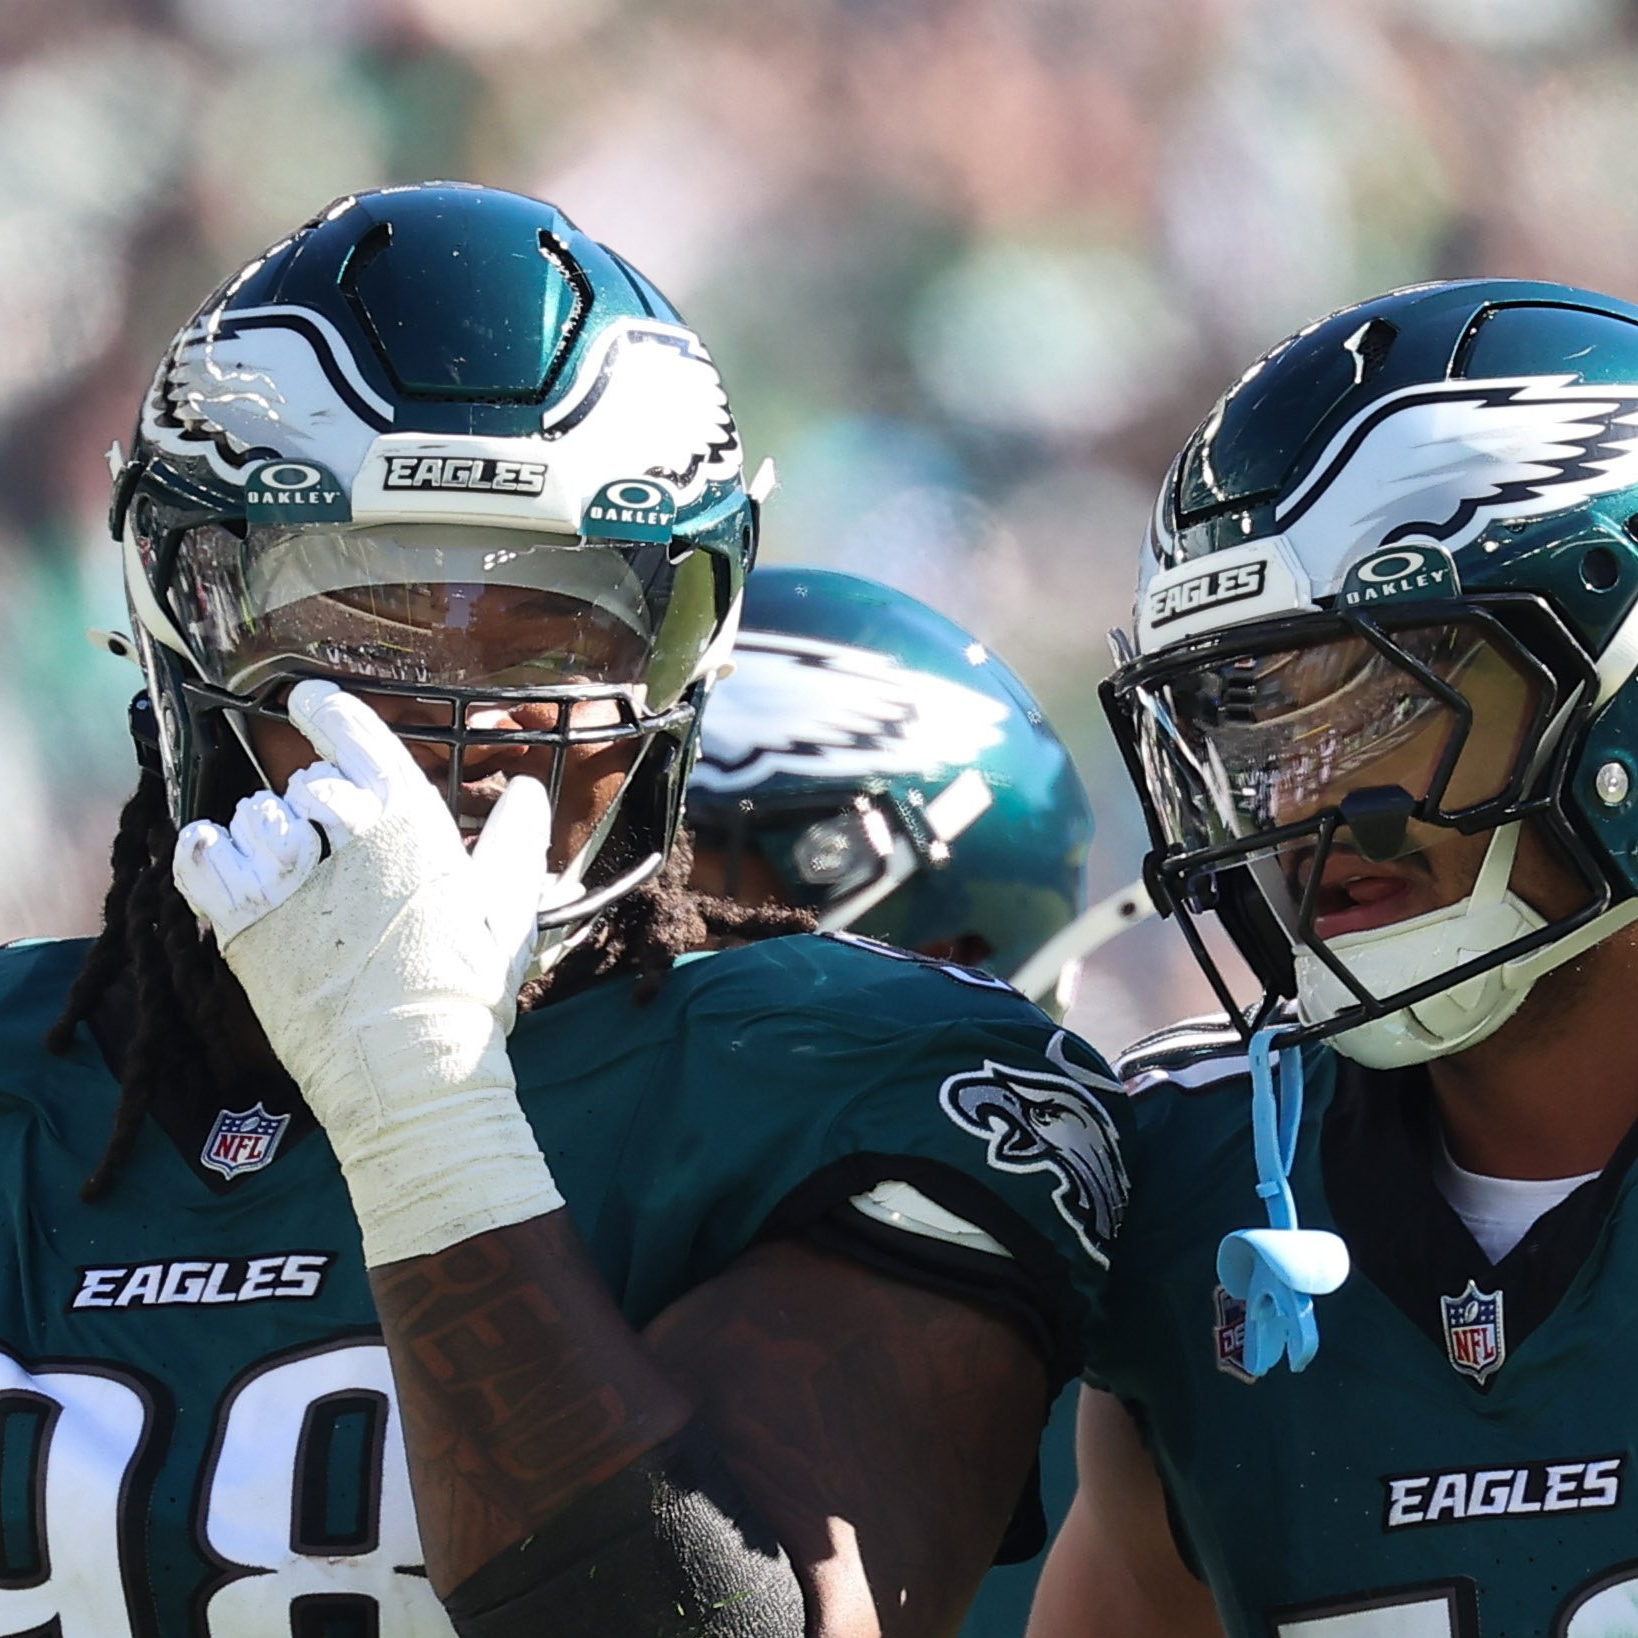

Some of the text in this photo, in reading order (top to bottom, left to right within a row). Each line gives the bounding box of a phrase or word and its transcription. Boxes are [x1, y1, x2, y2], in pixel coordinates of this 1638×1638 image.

[387, 457, 546, 492] EAGLES
[248, 490, 337, 505] OAKLEY
[590, 505, 673, 526] OAKLEY
[1150, 563, 1262, 618] EAGLES
[1345, 568, 1447, 605] OAKLEY
[212, 1133, 264, 1163] NFL
[72, 1255, 329, 1308] EAGLES
[1453, 1327, 1496, 1366] NFL
[1388, 1459, 1621, 1527] EAGLES
